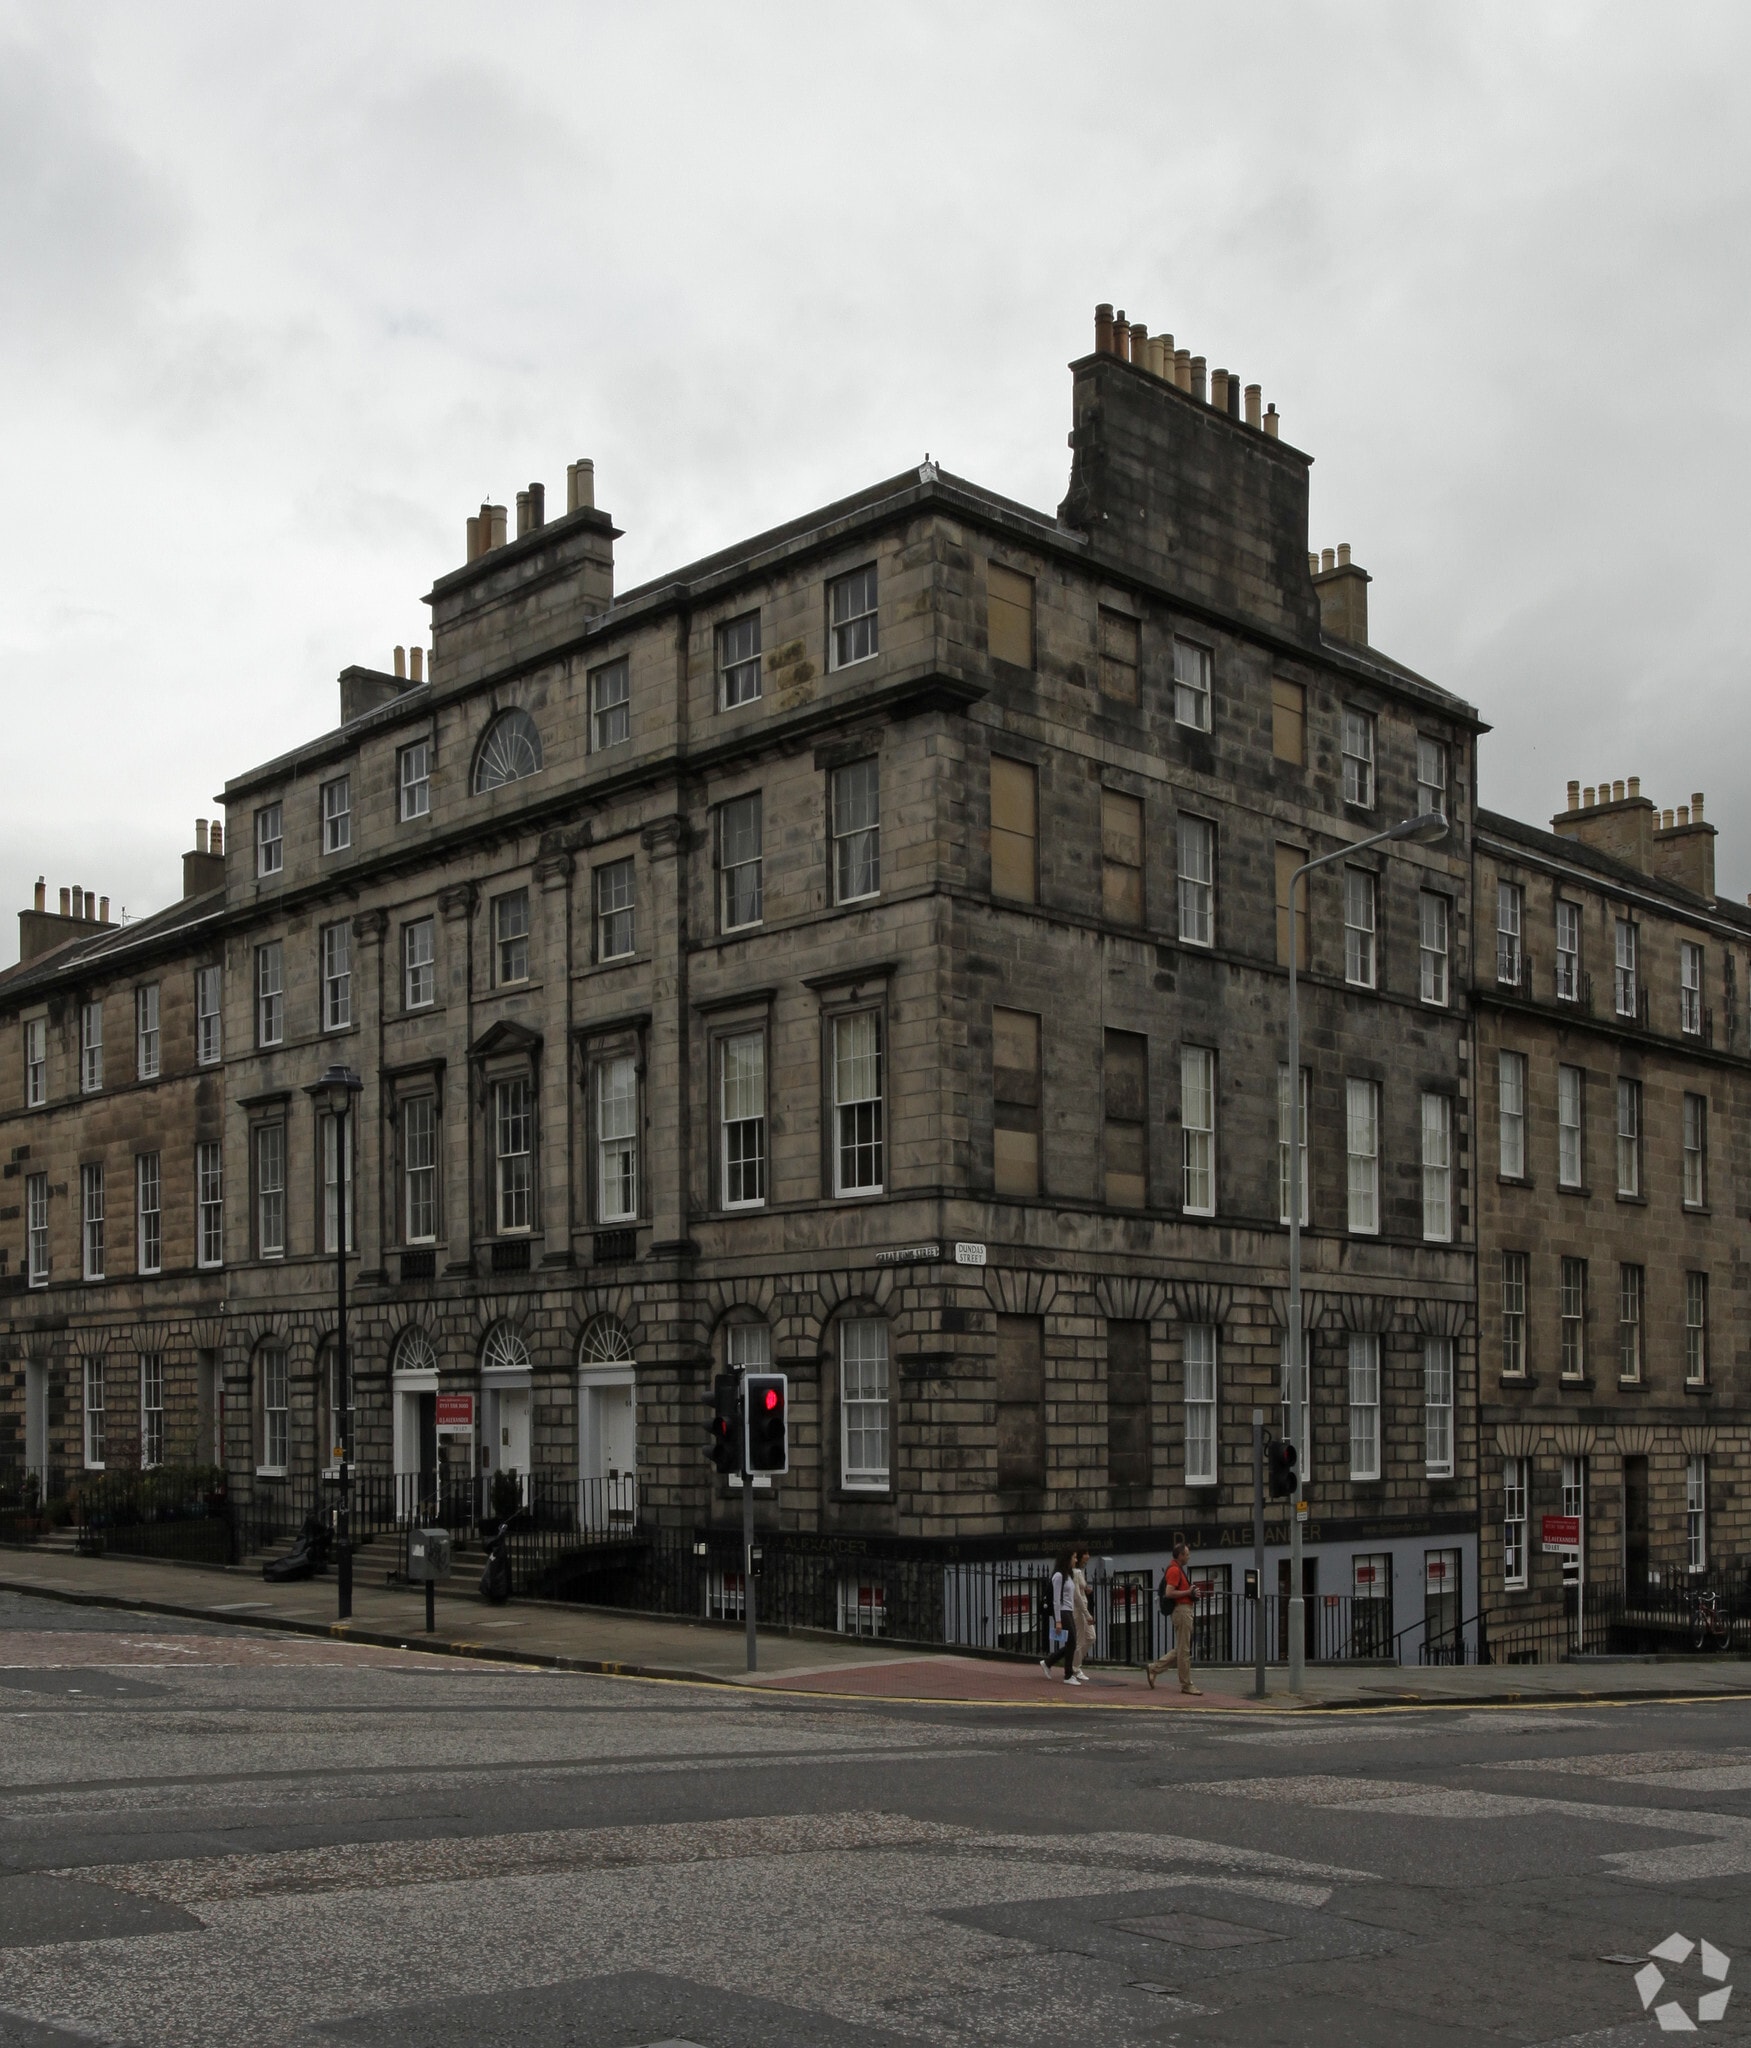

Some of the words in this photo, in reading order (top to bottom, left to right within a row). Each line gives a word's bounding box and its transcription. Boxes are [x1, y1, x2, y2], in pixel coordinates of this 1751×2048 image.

[877, 1251, 897, 1263] GREAT
[916, 1247, 939, 1259] STREET
[958, 1244, 984, 1254] DUNDAS
[959, 1254, 982, 1263] STREET
[1219, 1524, 1322, 1546] ALEANER
